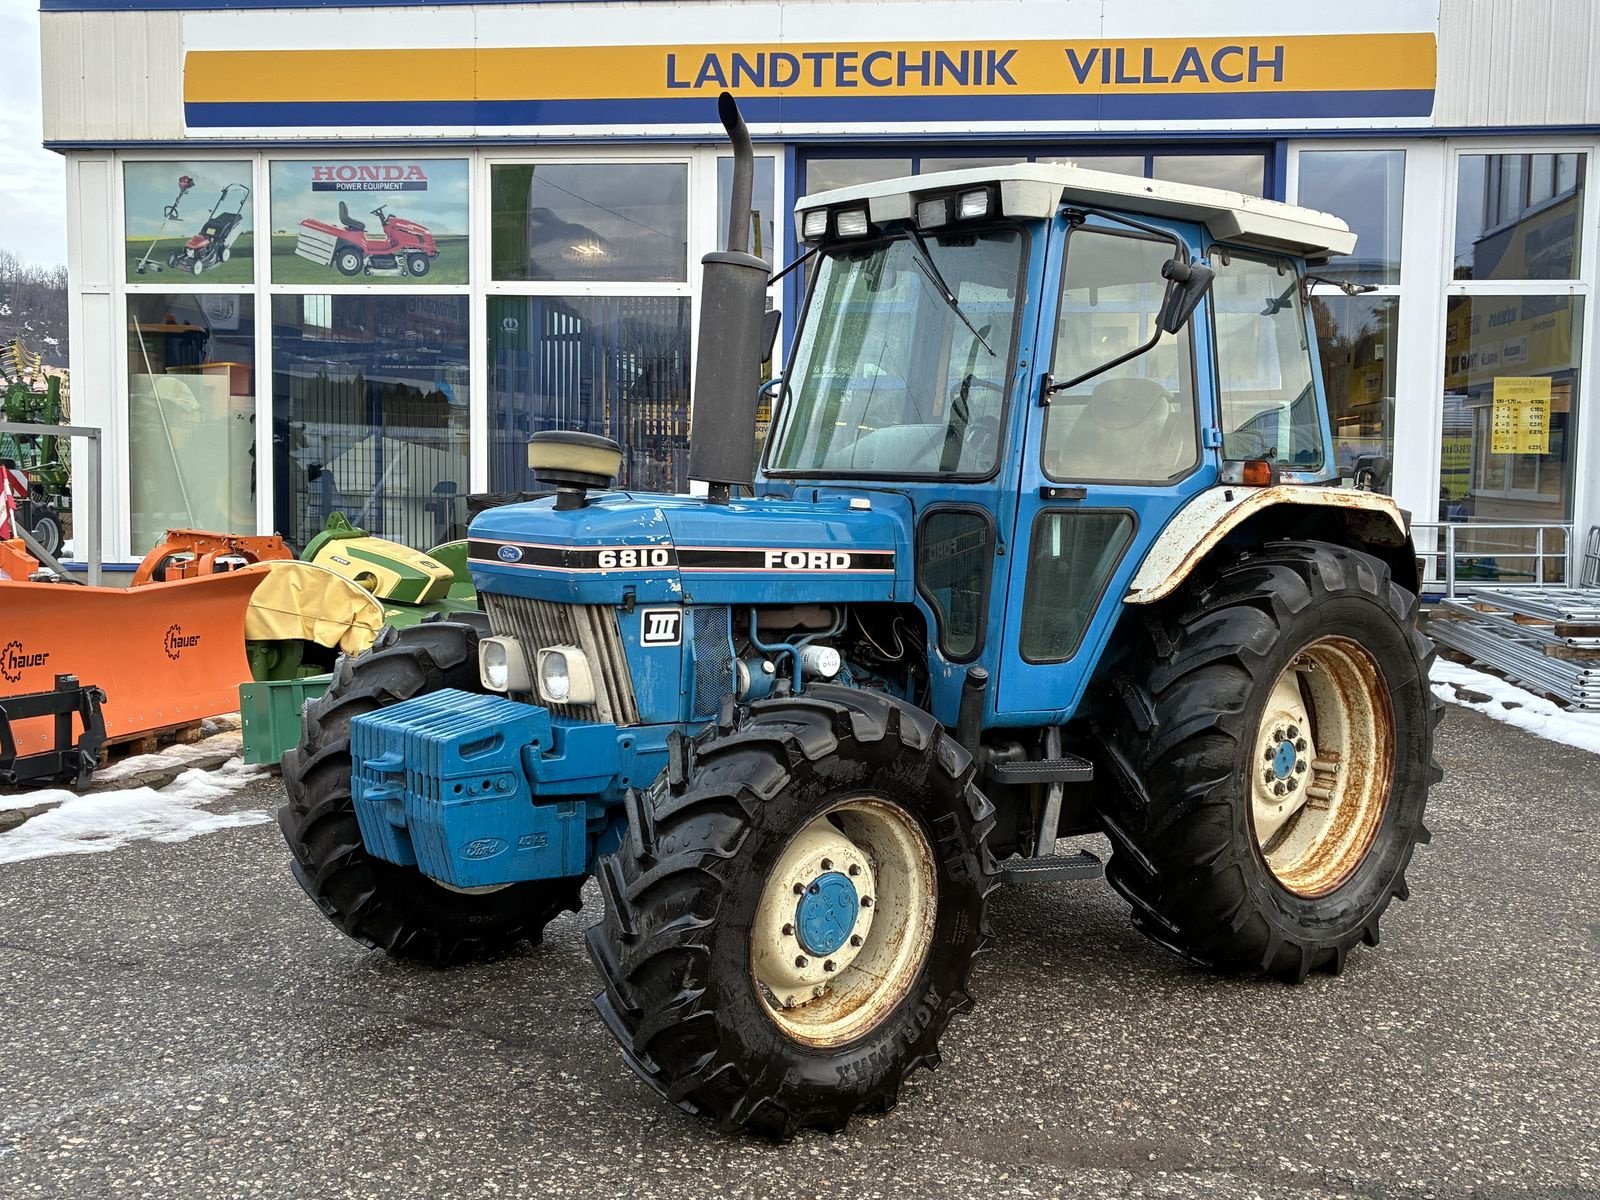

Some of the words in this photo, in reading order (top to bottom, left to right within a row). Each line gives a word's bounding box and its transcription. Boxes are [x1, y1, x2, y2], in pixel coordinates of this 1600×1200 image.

[666, 49, 1017, 88] LANDTECHNIK
[1065, 45, 1284, 84] VILLACH
[312, 165, 427, 181] HONDA
[502, 549, 516, 559] Ford
[598, 549, 669, 568] 6810
[764, 551, 851, 569] FORD
[645, 613, 679, 641] III
[170, 632, 200, 649] hauer
[8, 651, 49, 670] hauer
[466, 839, 499, 857] Ford
